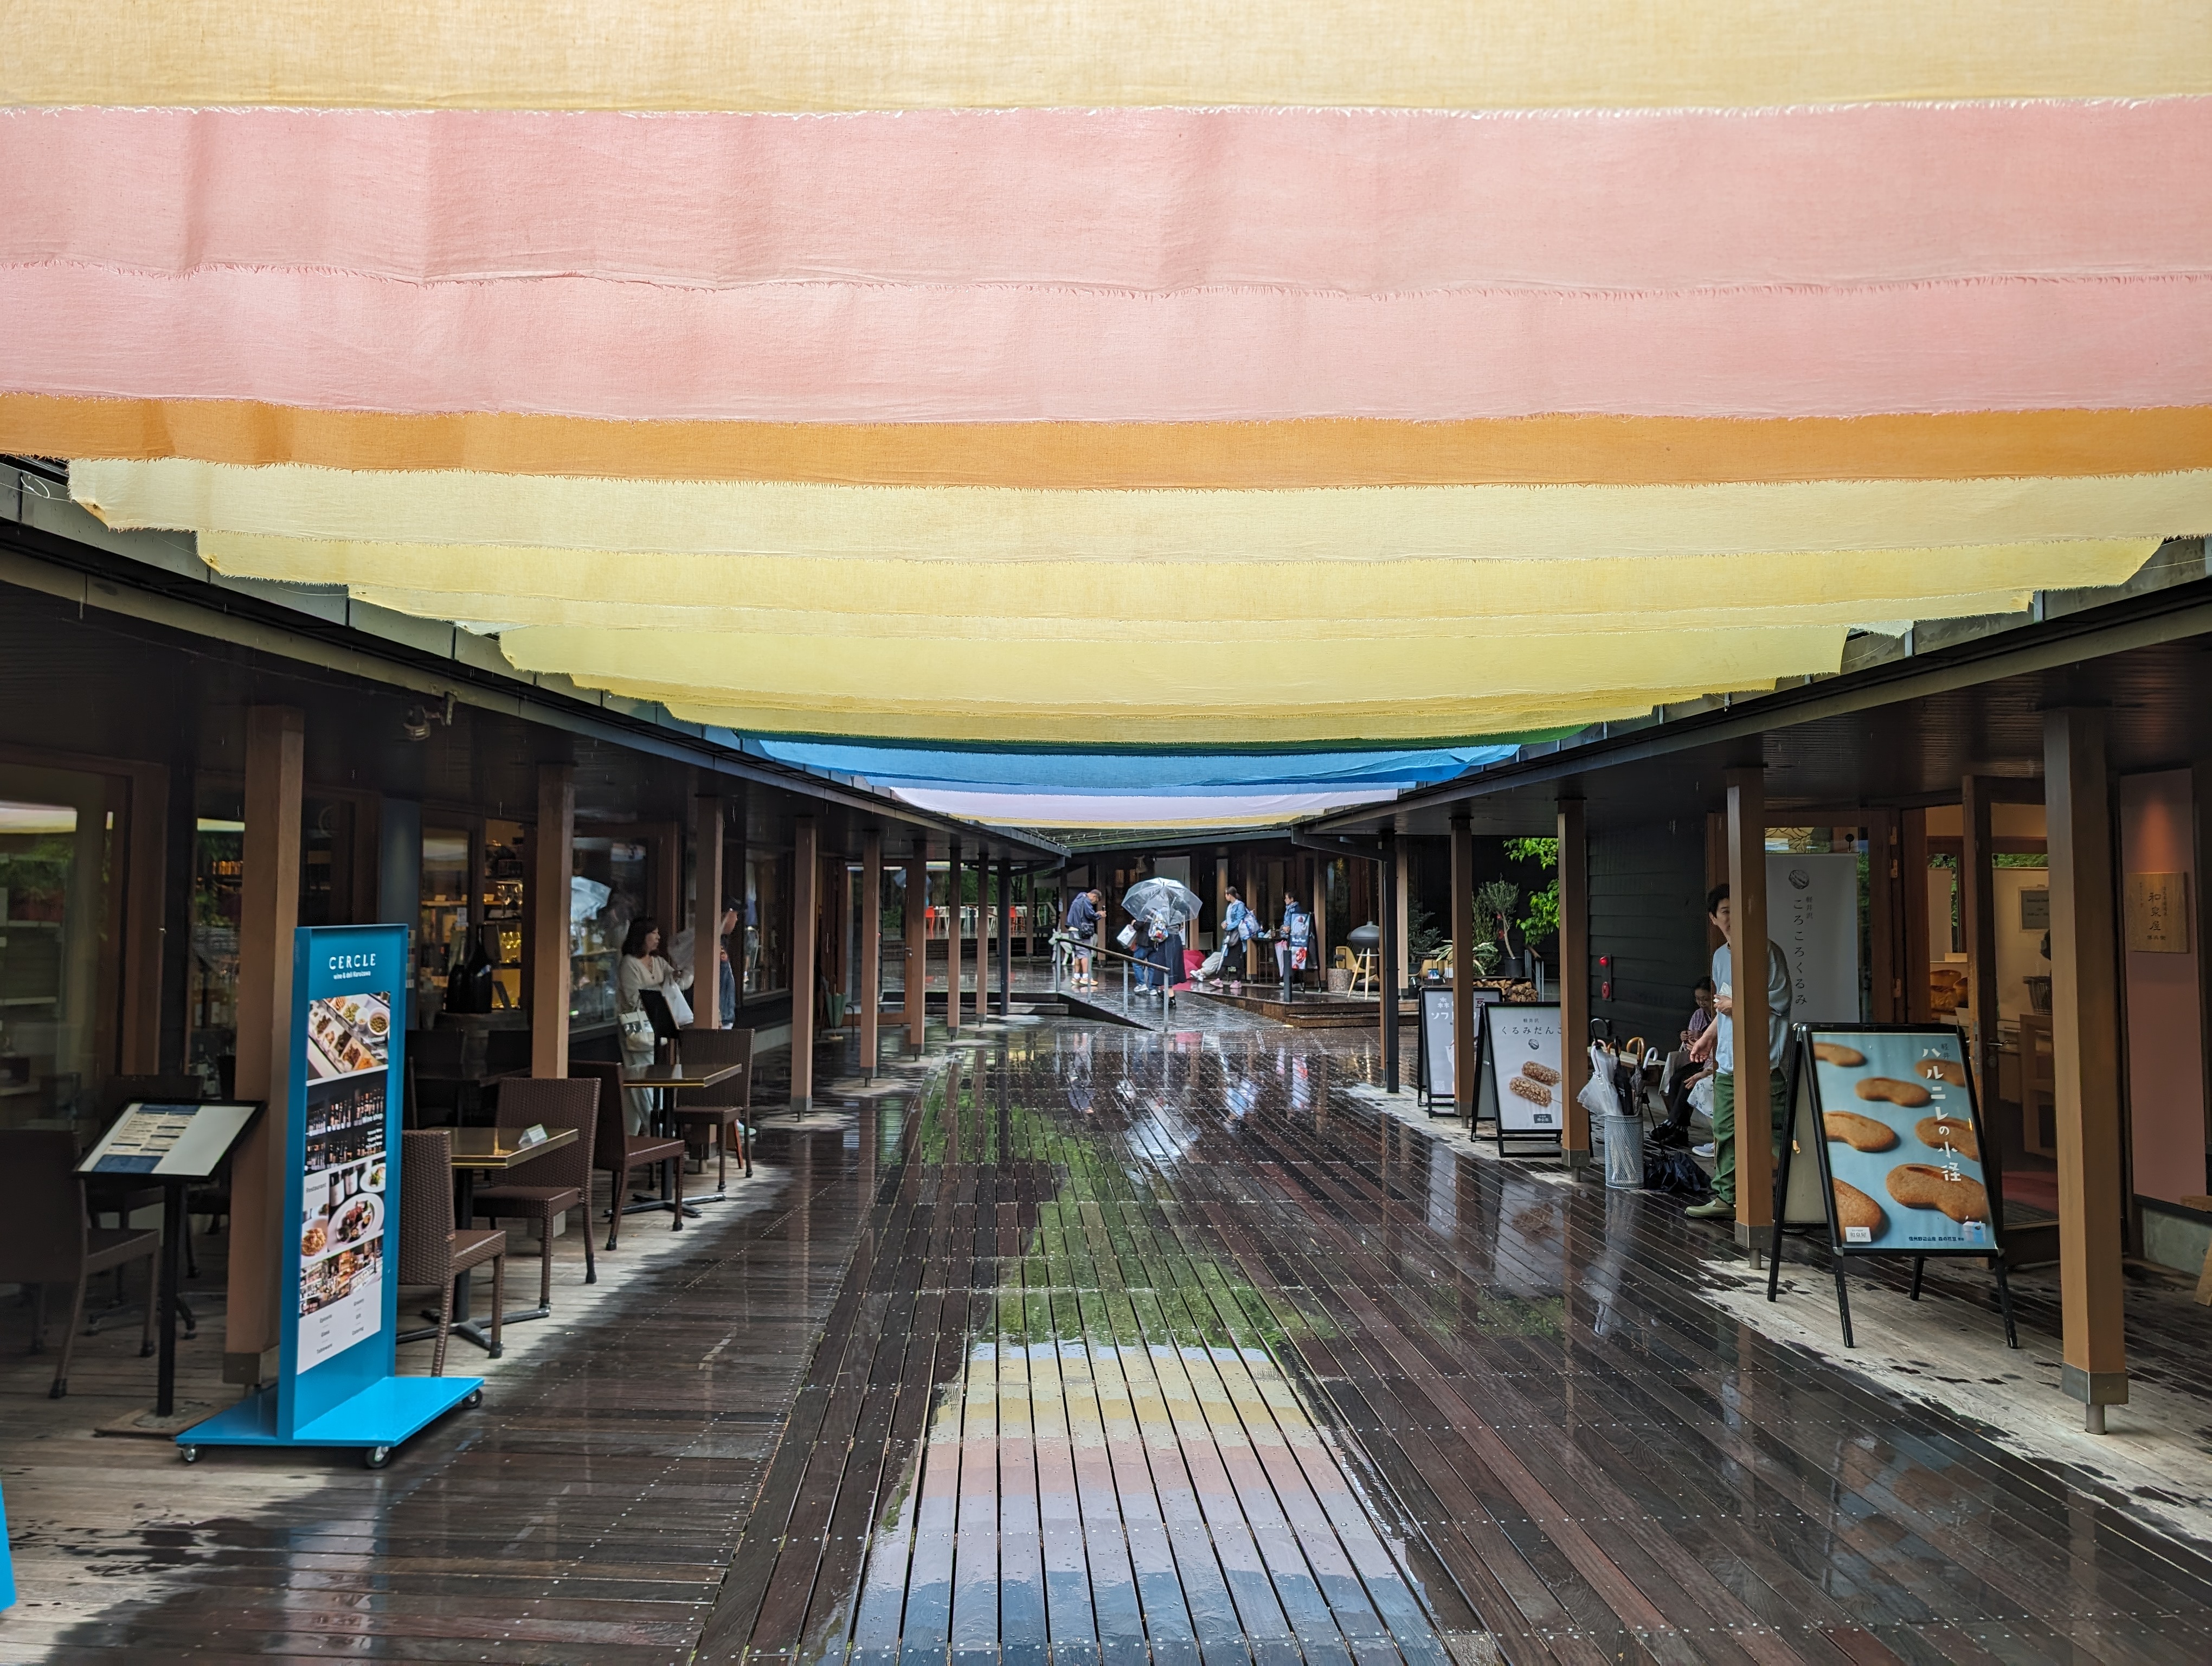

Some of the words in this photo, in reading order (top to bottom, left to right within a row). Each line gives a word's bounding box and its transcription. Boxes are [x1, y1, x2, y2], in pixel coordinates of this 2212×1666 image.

[2148, 892, 2162, 931] 和泉屋
[329, 953, 376, 970] CERCLE
[1793, 899, 1808, 1005] ころころくるみ
[1922, 1048, 1962, 1181] ハルニレの小径
